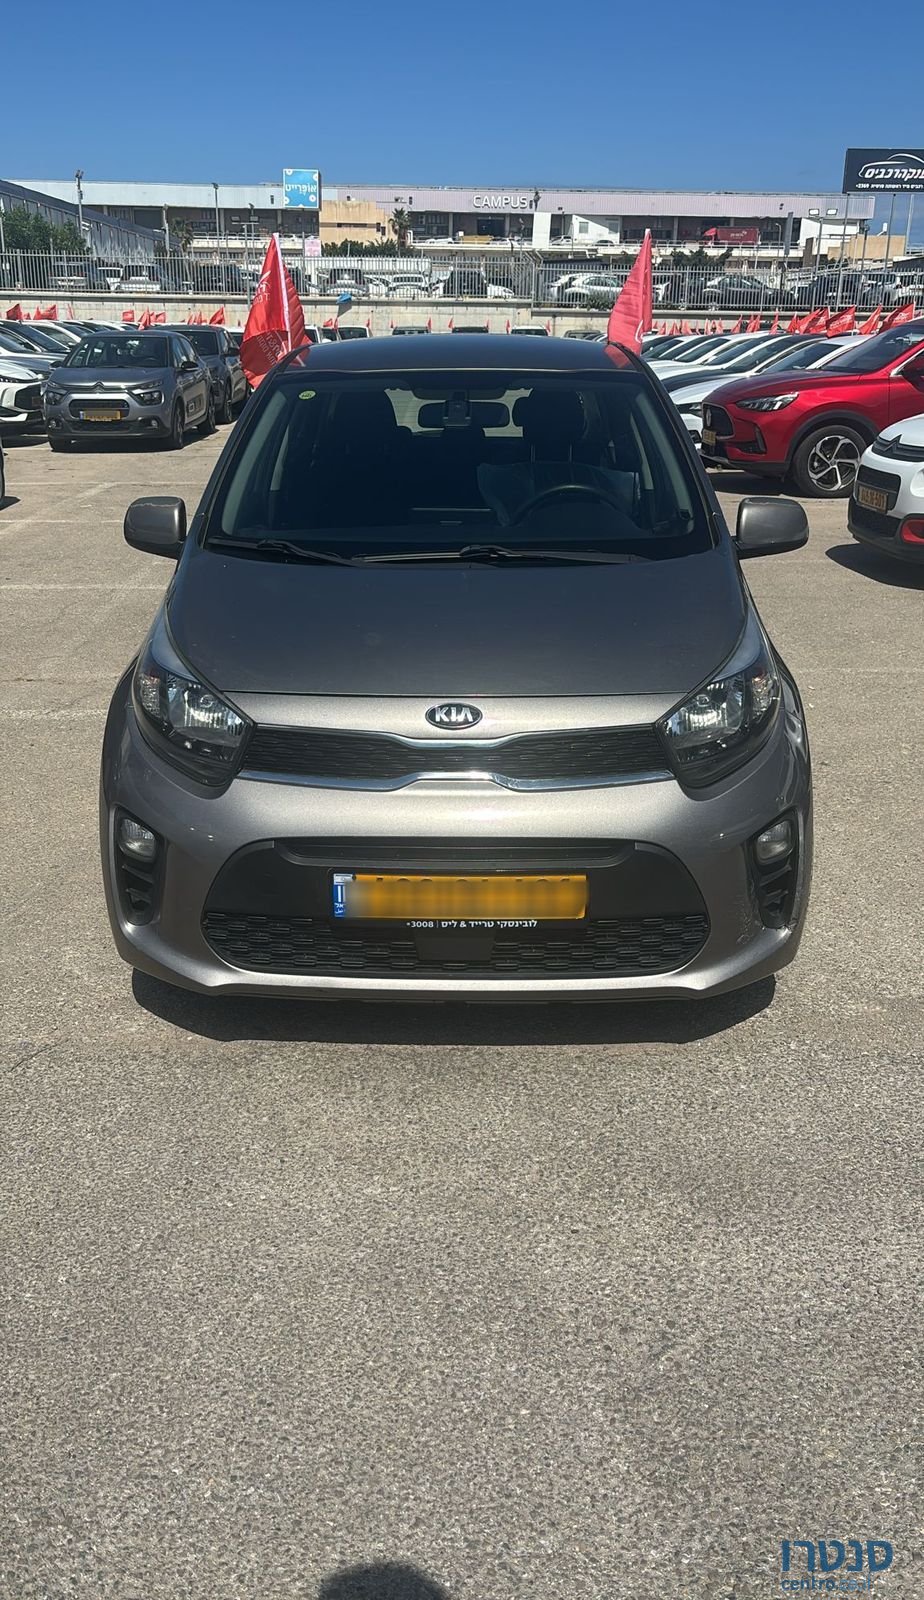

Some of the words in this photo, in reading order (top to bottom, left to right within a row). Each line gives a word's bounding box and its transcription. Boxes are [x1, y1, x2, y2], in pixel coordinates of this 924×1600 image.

[473, 195, 528, 208] CAMPUS
[435, 706, 474, 722] KIA
[441, 919, 458, 928] ליס
[459, 920, 467, 928] &
[468, 920, 495, 928] טרייד
[497, 919, 538, 929] לובינסקי
